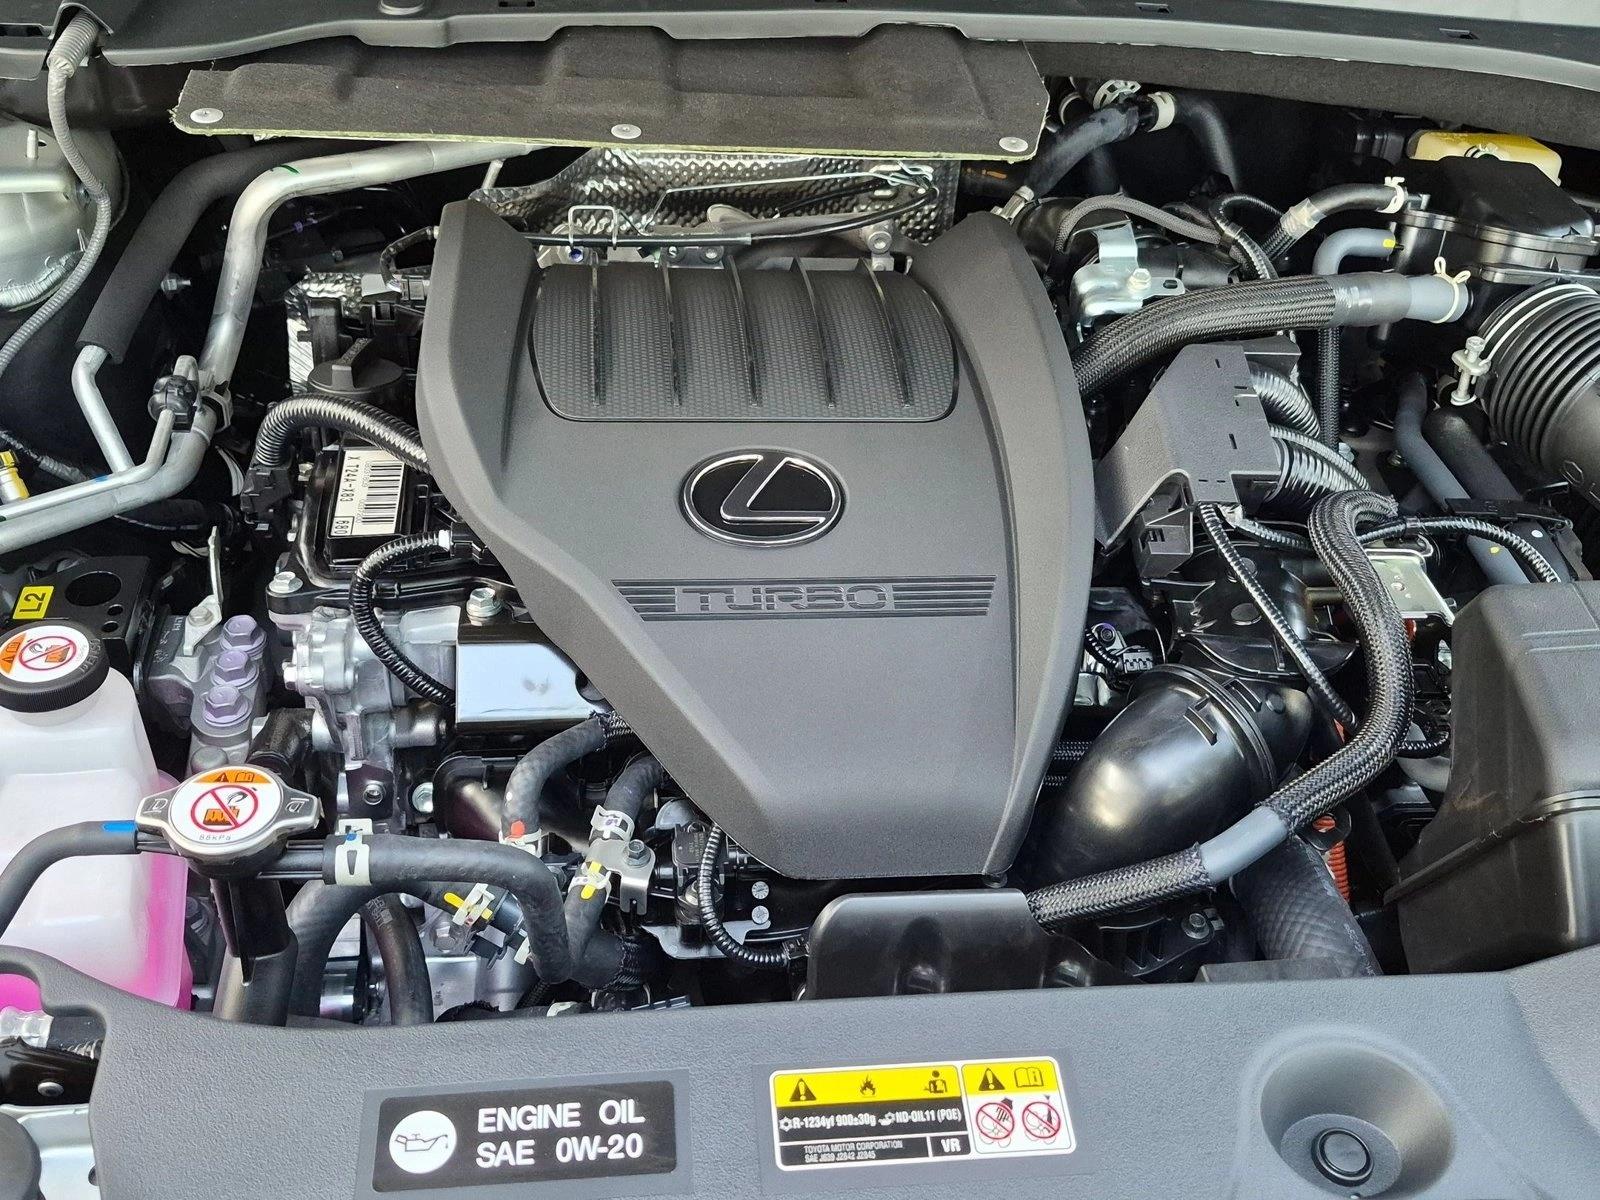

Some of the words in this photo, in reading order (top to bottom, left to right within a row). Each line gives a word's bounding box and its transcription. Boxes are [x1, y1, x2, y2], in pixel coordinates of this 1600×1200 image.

[20, 592, 47, 613] L2
[682, 585, 888, 611] TURBO
[477, 1101, 582, 1133] ENGINE
[598, 1098, 646, 1126] OIL
[937, 1107, 962, 1123] (POE)
[475, 1139, 536, 1169] SAE
[555, 1132, 644, 1163] 0W-20
[804, 1144, 831, 1154] TOYOTA
[831, 1142, 856, 1152] MOTOR
[856, 1140, 903, 1151] CORPORATION
[941, 1137, 961, 1153] VR
